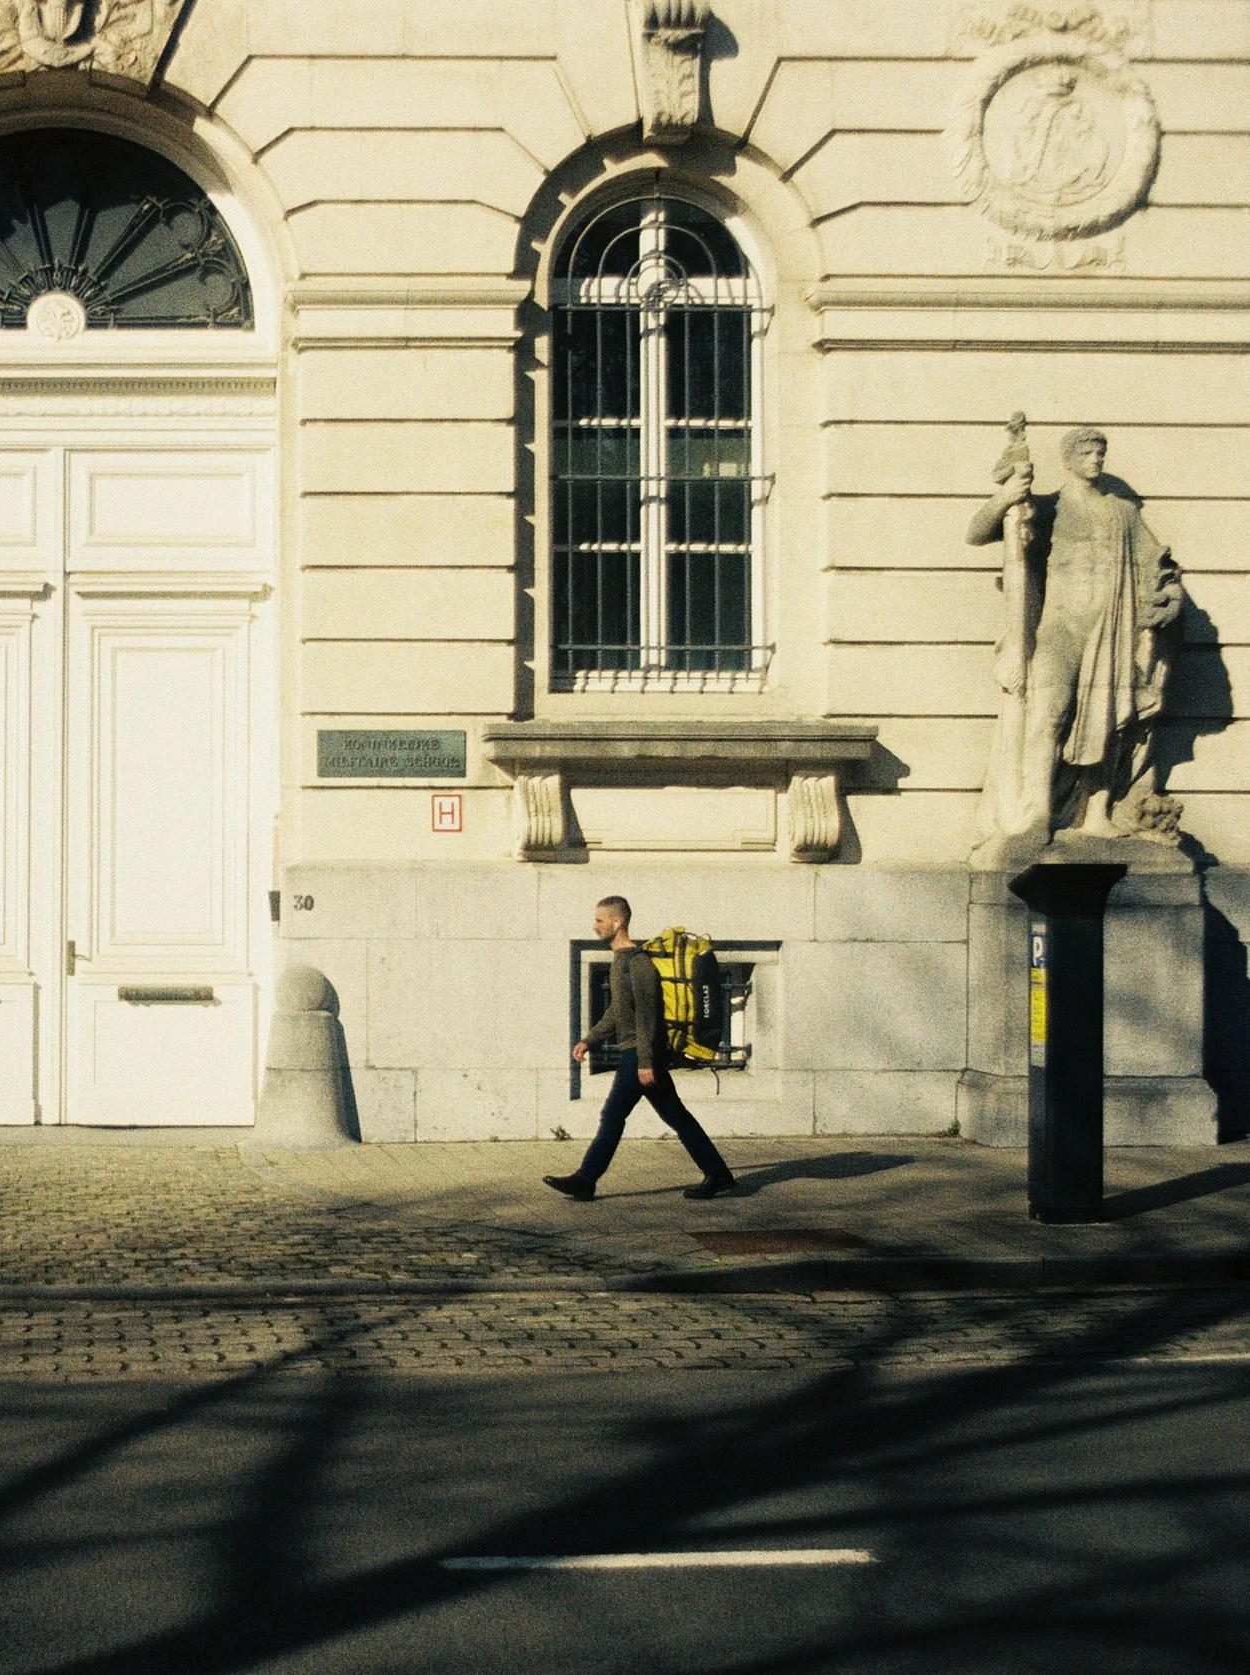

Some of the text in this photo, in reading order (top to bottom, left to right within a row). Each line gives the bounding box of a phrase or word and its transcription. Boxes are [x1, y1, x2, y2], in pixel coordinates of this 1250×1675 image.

[438, 802, 455, 824] H
[293, 895, 314, 911] 30
[1033, 936, 1043, 966] P
